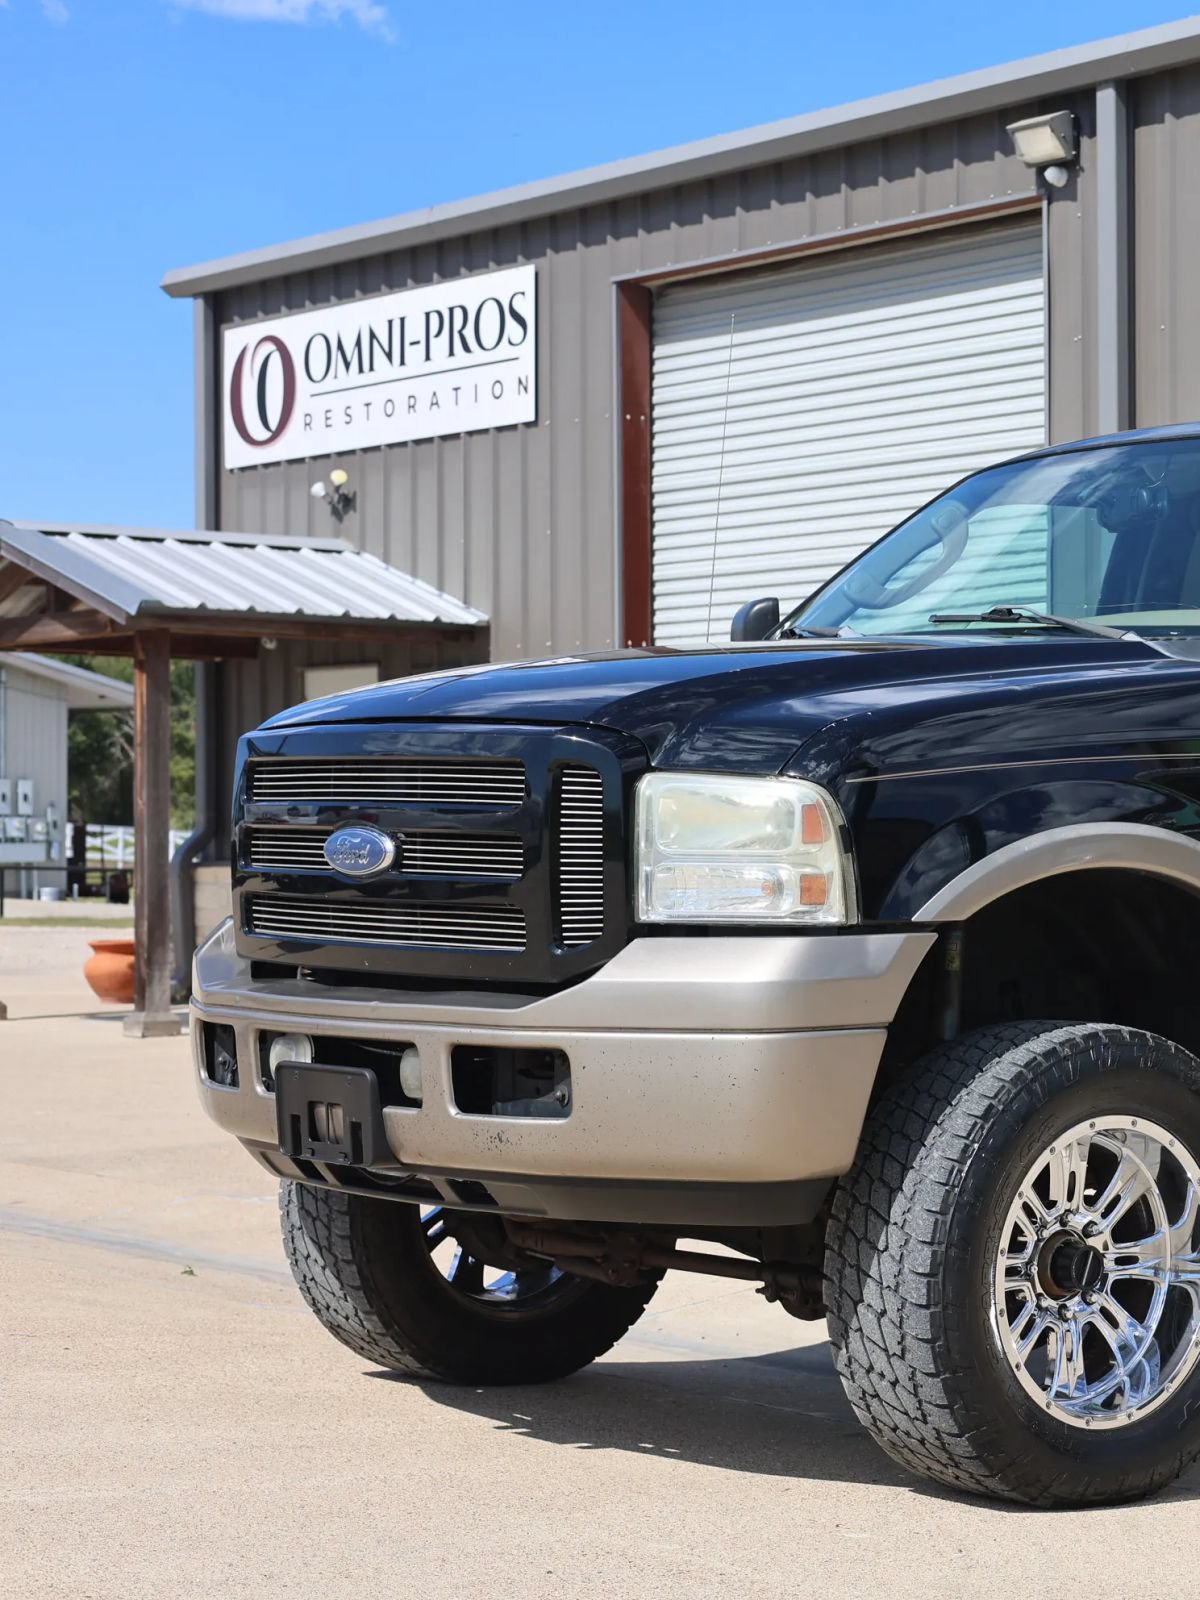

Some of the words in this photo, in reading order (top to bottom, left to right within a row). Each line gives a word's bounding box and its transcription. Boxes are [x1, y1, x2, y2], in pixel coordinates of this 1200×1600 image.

[303, 291, 529, 384] OMNI-PROS
[303, 375, 529, 431] RESTORATION
[333, 835, 372, 865] Ford
